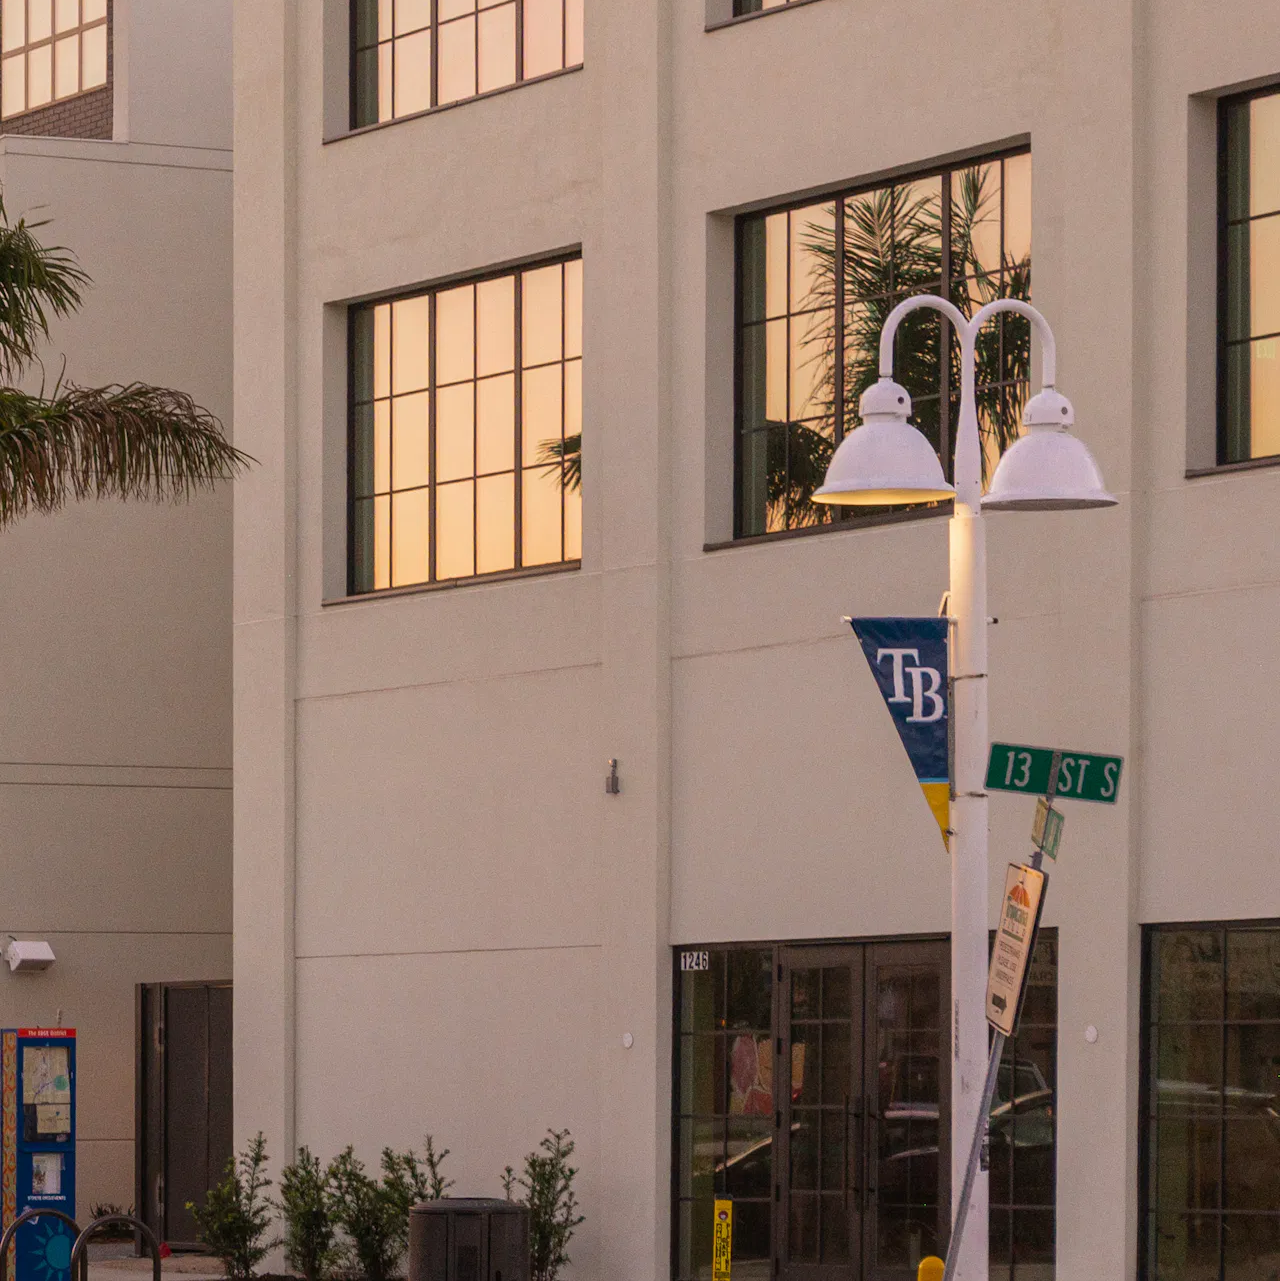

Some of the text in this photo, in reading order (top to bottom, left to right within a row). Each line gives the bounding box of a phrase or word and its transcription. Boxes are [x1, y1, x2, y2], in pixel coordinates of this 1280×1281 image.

[877, 648, 945, 723] TB
[1005, 751, 1117, 798] 13 ST S
[683, 952, 708, 970] 1246
